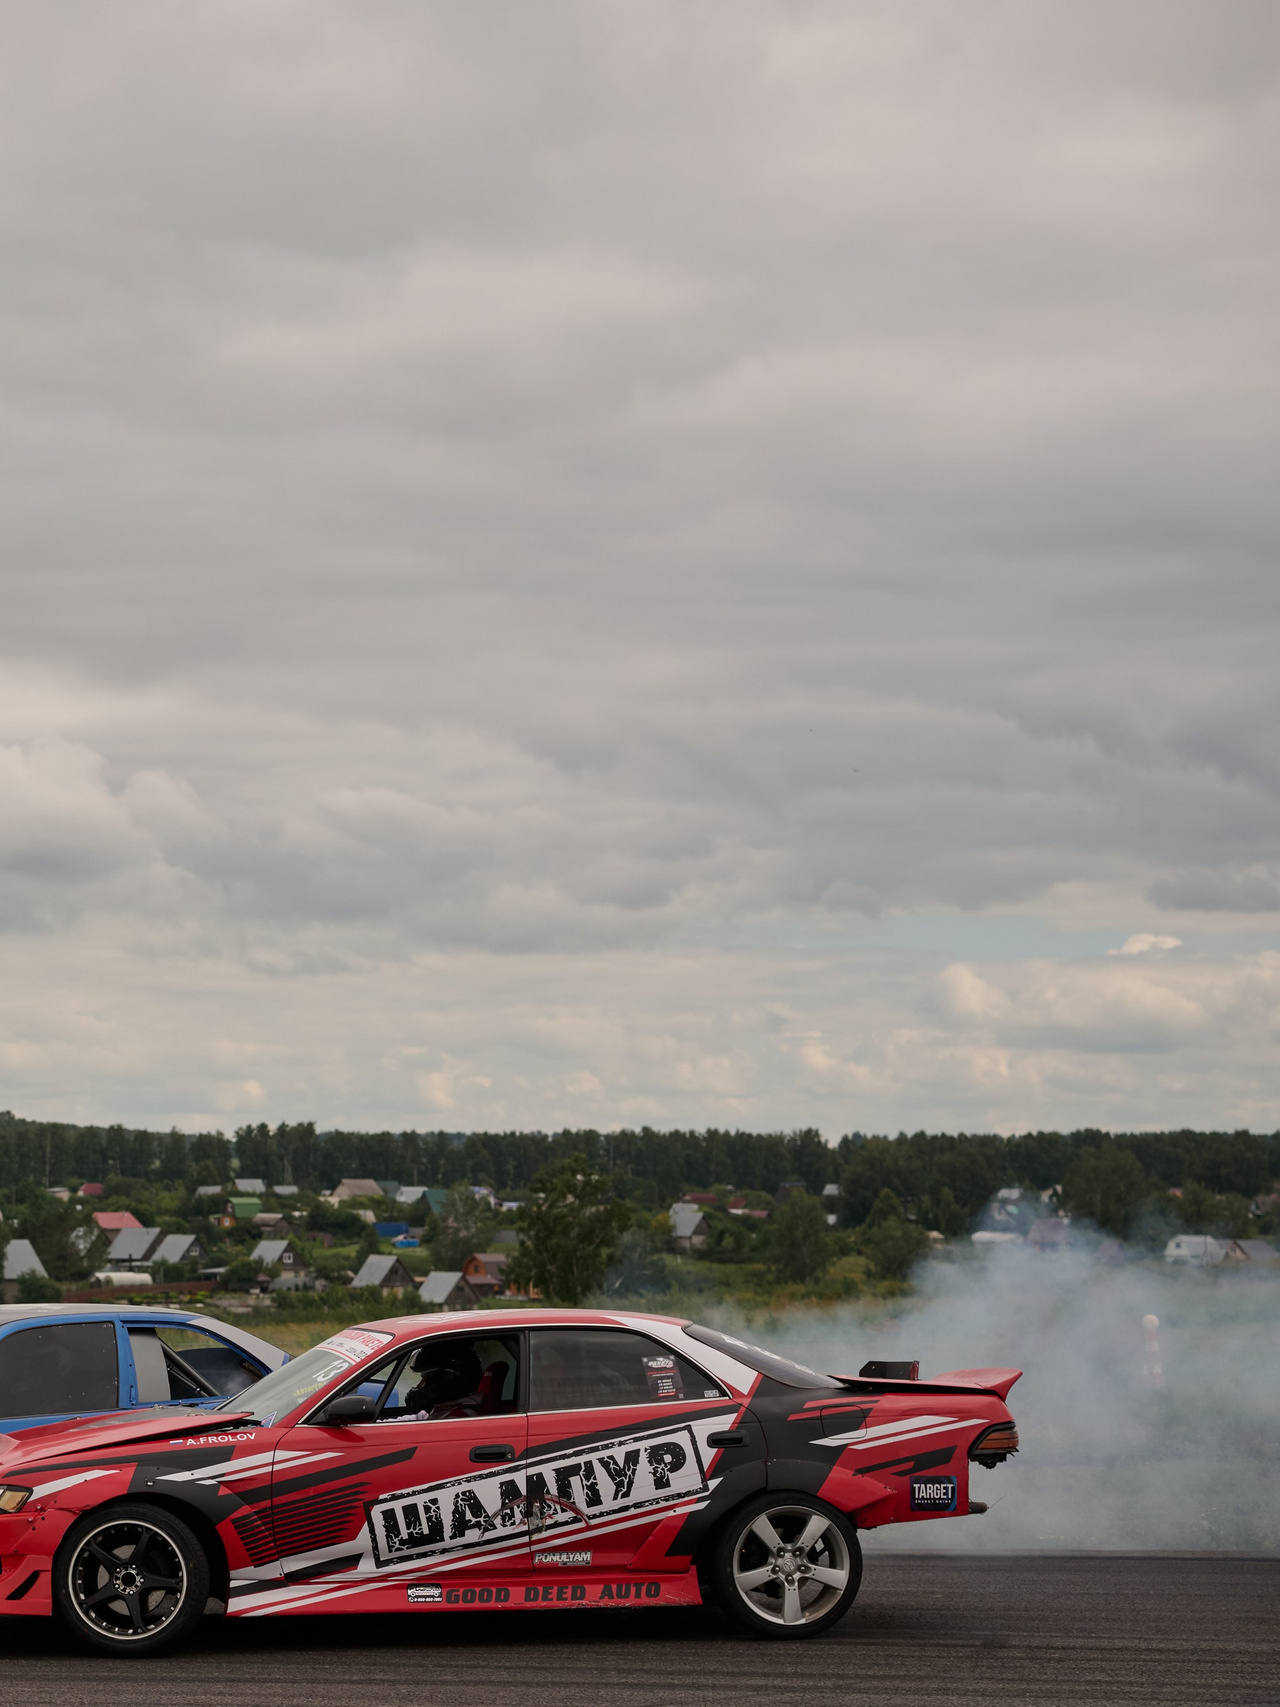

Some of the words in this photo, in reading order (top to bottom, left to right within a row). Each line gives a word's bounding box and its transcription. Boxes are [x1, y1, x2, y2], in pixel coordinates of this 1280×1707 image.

[312, 1359, 349, 1382] 13
[186, 1433, 256, 1446] A.FROLOV
[381, 1441, 687, 1553] ШАМПУР
[913, 1483, 953, 1499] TARGET
[534, 1551, 592, 1564] PONULYAM
[446, 1587, 511, 1605] GOOD
[524, 1584, 587, 1603] DEED
[599, 1582, 662, 1600] AUTO
